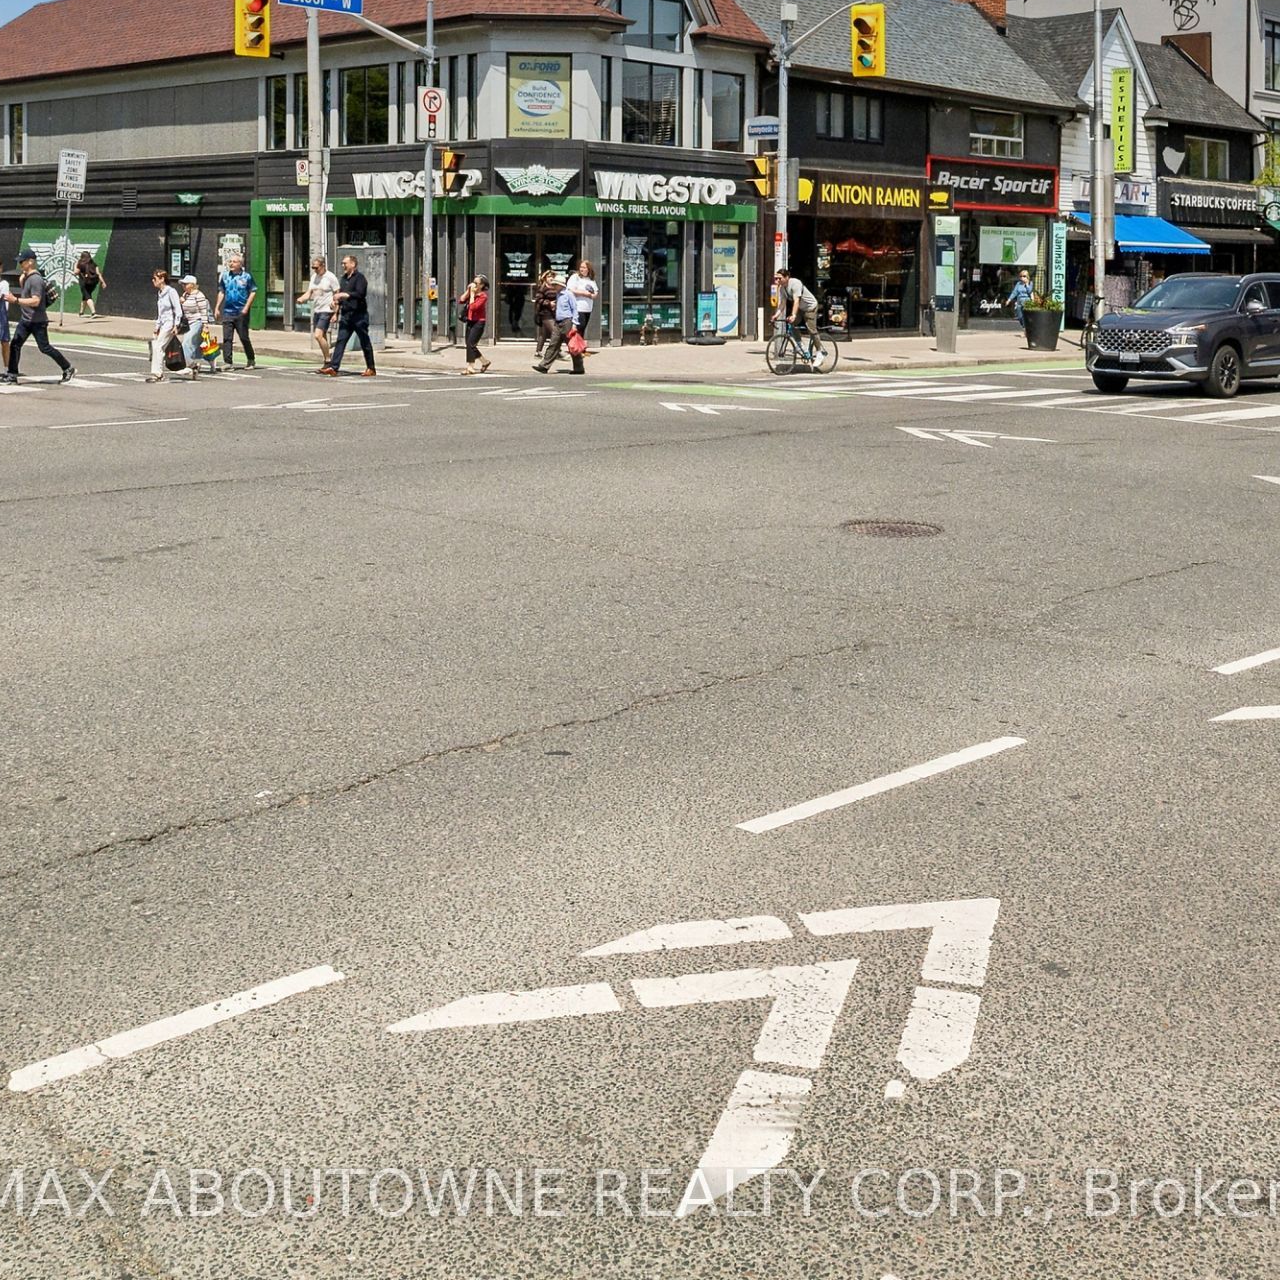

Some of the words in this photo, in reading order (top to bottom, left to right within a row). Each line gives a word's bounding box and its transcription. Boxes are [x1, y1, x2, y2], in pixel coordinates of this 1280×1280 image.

[1117, 76, 1125, 161] ESTHETICS
[937, 171, 990, 190] Racer
[992, 176, 1051, 195] Sportif
[822, 184, 872, 205] KINTON
[876, 187, 920, 207] RAMEN
[1174, 194, 1225, 209] STARBUCKS
[1226, 198, 1257, 212] COFFEE
[595, 202, 626, 214] WINGS.
[628, 204, 650, 215] FRIES.
[653, 205, 686, 216] FLAVOUR
[1054, 233, 1065, 270] Janina's
[1054, 273, 1065, 301] Esthe
